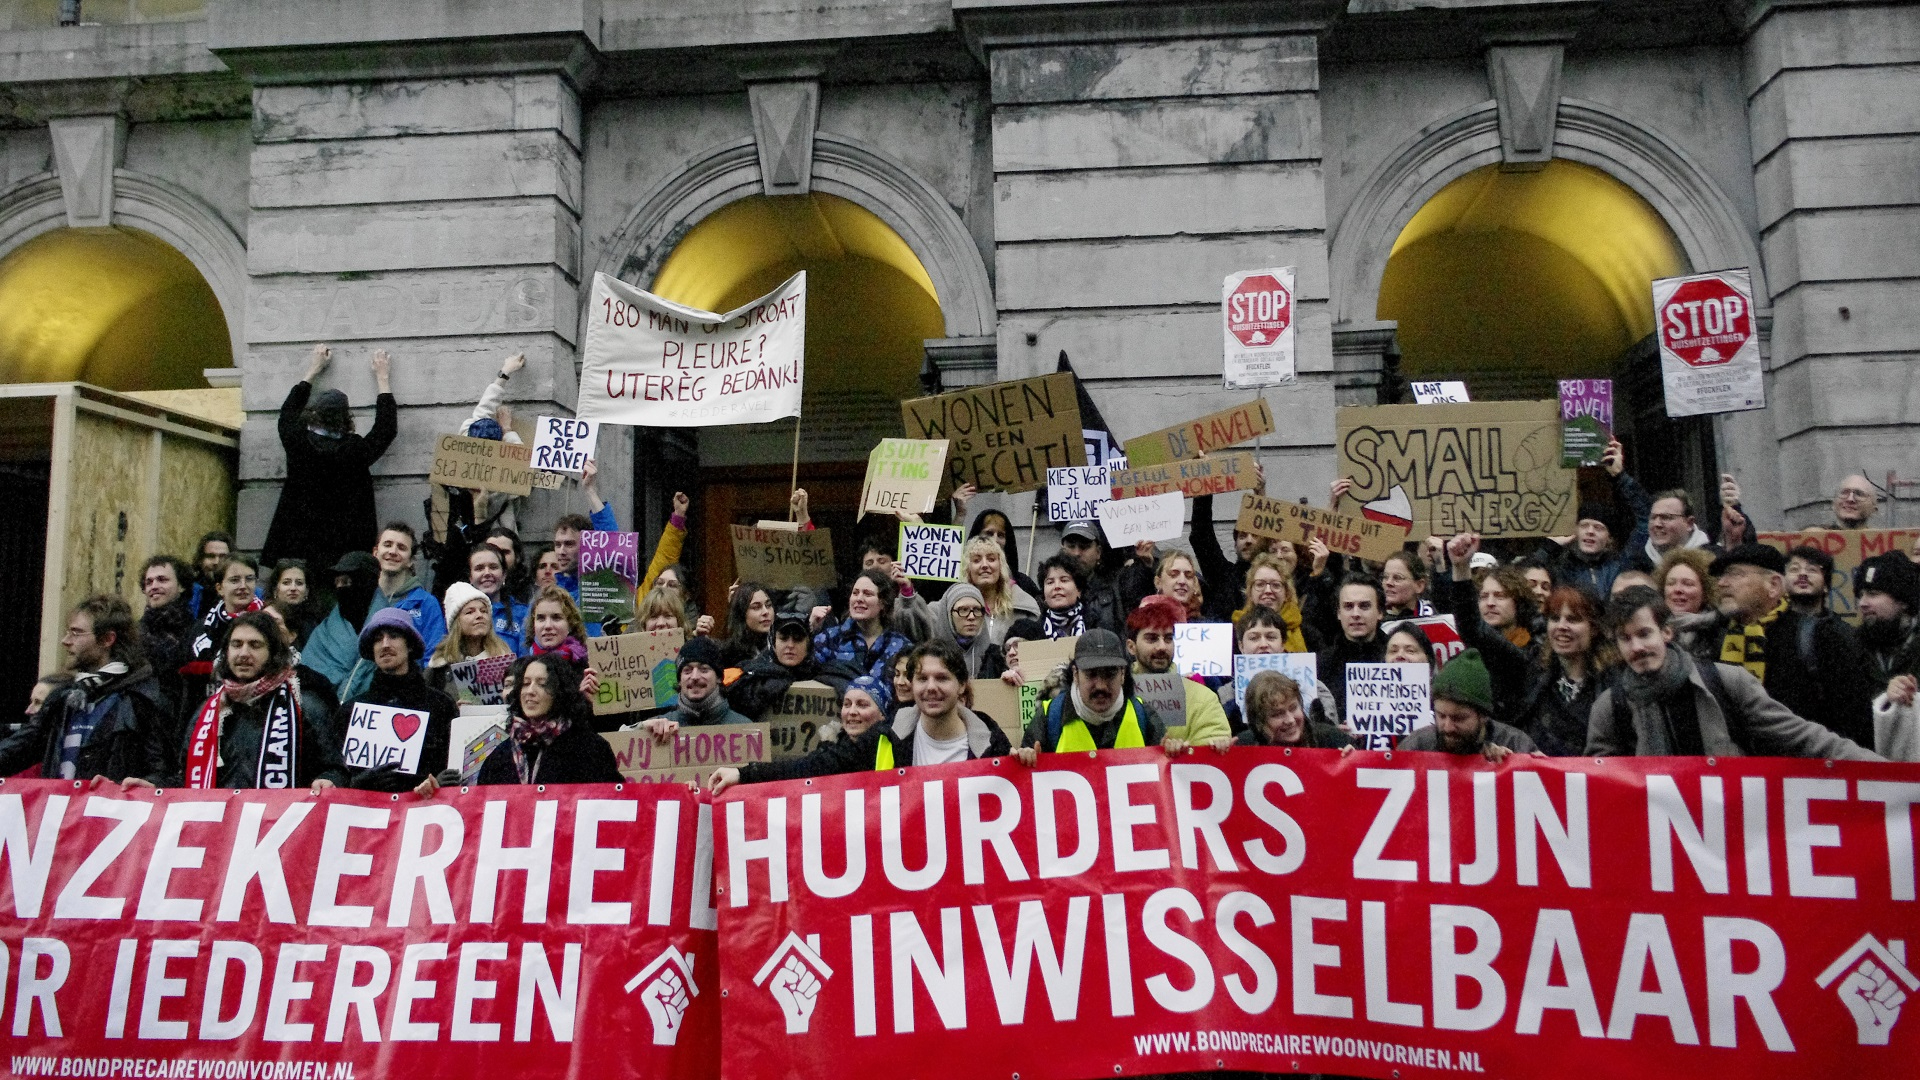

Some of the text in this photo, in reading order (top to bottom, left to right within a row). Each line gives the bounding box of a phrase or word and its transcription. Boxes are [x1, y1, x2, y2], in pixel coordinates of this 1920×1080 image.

[603, 297, 640, 329] 180
[734, 293, 800, 330] STROAT
[1232, 290, 1286, 323] STOP
[1666, 296, 1743, 340] STOP
[662, 333, 767, 370] PLEURE?
[1415, 382, 1442, 395] LAAT
[1560, 380, 1607, 398] RED DE
[911, 379, 1055, 439] WONEN
[549, 418, 589, 439] RED
[1168, 404, 1270, 458] DE RAVEL!
[441, 435, 493, 457] Gemeente
[553, 437, 574, 450] DE
[955, 429, 1024, 452] IS EEN
[461, 458, 497, 483] achter
[951, 433, 1072, 491] RECHT!
[1181, 462, 1212, 479] KUN
[1221, 458, 1241, 475] JE
[1344, 425, 1518, 502] SMALL
[1048, 468, 1078, 486] KIES
[1176, 475, 1236, 493] WONEN
[876, 490, 911, 510] IDEE
[1065, 487, 1079, 500] JE
[1245, 495, 1382, 537] JAAG ONS NIET UIT
[1430, 490, 1571, 537] ENERGY
[582, 530, 633, 550] RED DE
[904, 526, 963, 544] WONEN
[1253, 515, 1362, 553] ONS THUIS
[923, 543, 951, 558] EEN
[581, 550, 636, 579] RAVEL!
[1348, 667, 1402, 681] HUIZEN
[1145, 679, 1173, 693] DAN
[1349, 683, 1427, 700] VOOR MENSEN
[1356, 701, 1422, 712] NIET VOOR
[351, 707, 381, 730] WE
[1352, 713, 1418, 734] WINST
[345, 737, 409, 771] RAVEL
[616, 731, 763, 770] WIJ HOREN
[726, 764, 1920, 908] HUURDERS ZIJN NIET
[851, 887, 1796, 1053] INWISSELBAAR
[105, 939, 581, 1043] IEDEREEN
[1133, 1031, 1485, 1073] WWW.BONDPRECAIREWOONVORMEN.NL
[11, 1056, 356, 1080] WWW.BONDPRECAIREWOONVORMEN.NL
